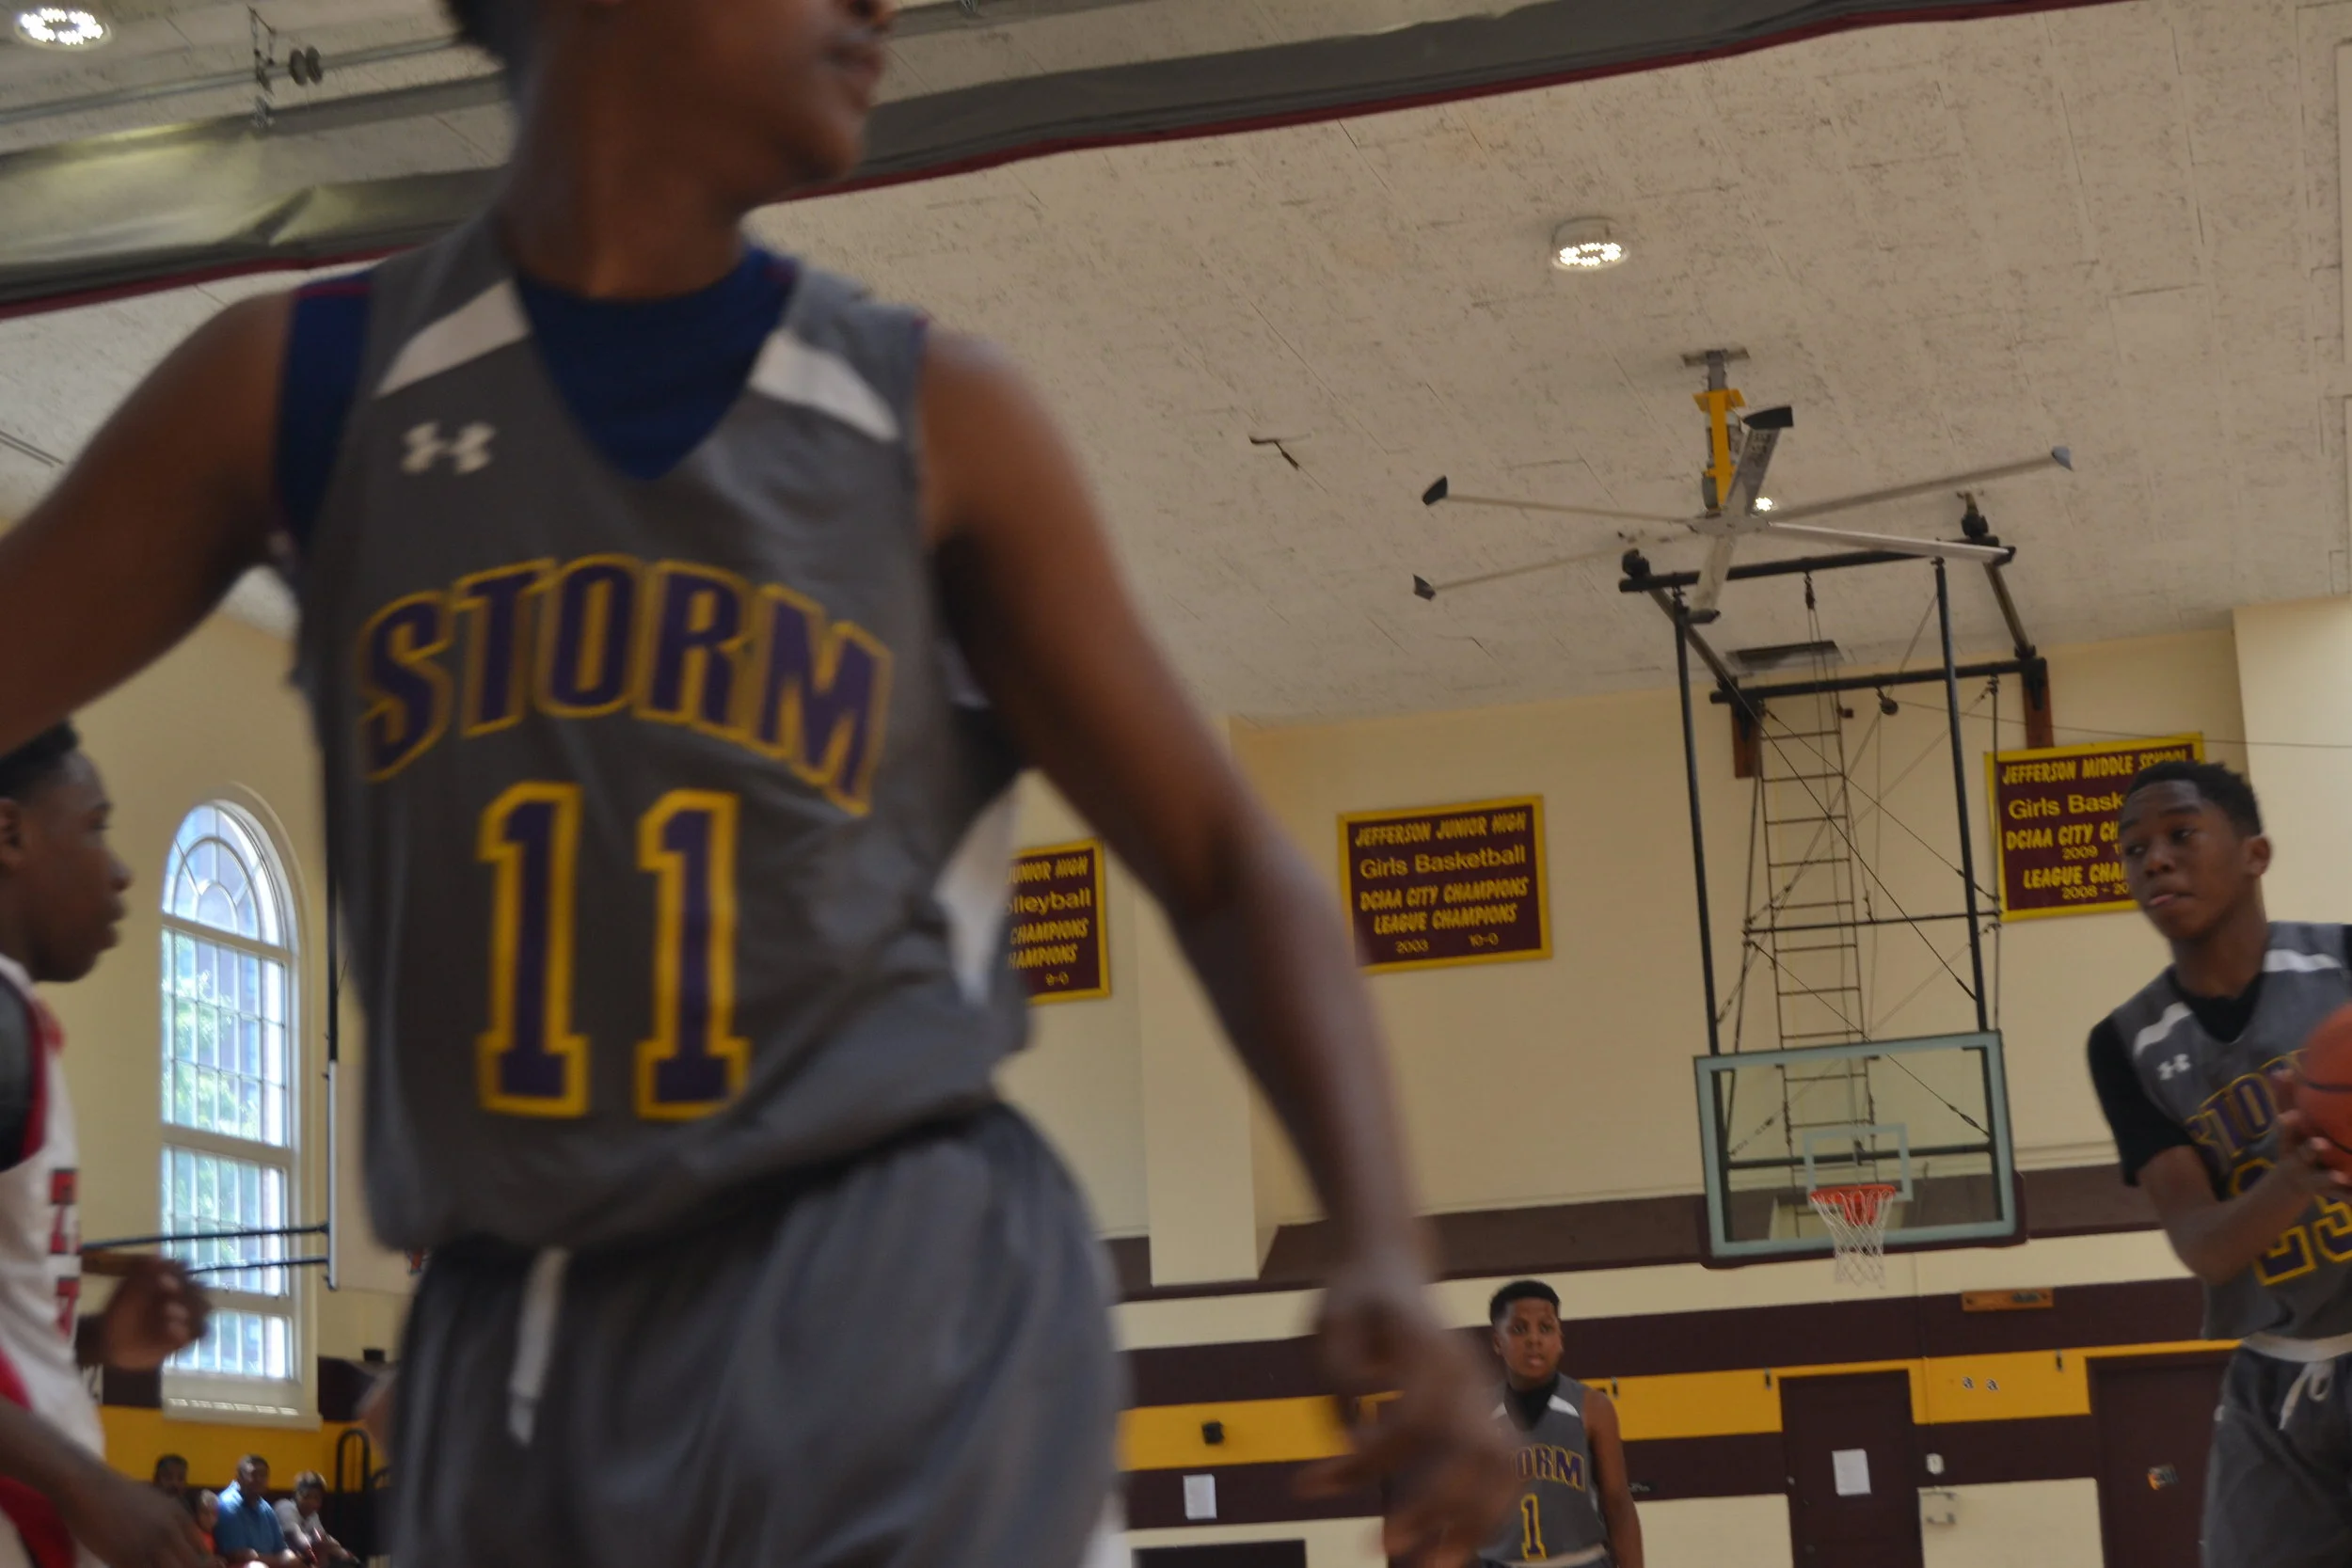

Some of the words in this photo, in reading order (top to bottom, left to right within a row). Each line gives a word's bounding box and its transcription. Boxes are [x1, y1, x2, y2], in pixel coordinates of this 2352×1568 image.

[356, 551, 895, 818] STORM
[2002, 759, 2076, 784] JEFFERSON
[2082, 755, 2134, 780] MIDDLE
[2009, 798, 2060, 819] Girls
[1355, 821, 1431, 847] JEFFERSON
[1436, 816, 1487, 840] JUNIOR
[1491, 811, 1526, 832] HIGH
[2006, 828, 2054, 850] DCIAA
[2058, 823, 2093, 846] CITY
[1055, 855, 1089, 879] HIGH
[1359, 857, 1408, 879] Girls
[1414, 845, 1526, 873] Basketball
[2024, 865, 2083, 889] LEAGUE
[1359, 888, 1403, 912] DCIAA
[1406, 885, 1438, 907] CITY
[1443, 876, 1530, 904] CHAMPIONS
[1010, 917, 1089, 945] CHAMPIONS
[1374, 911, 1427, 935] LEAGUE
[1432, 903, 1518, 929] CHAMPIONS
[475, 779, 751, 1120] 11
[1008, 942, 1078, 970] HAMPIONS
[1515, 1443, 1586, 1492] ORM
[1520, 1493, 1548, 1562] 1
